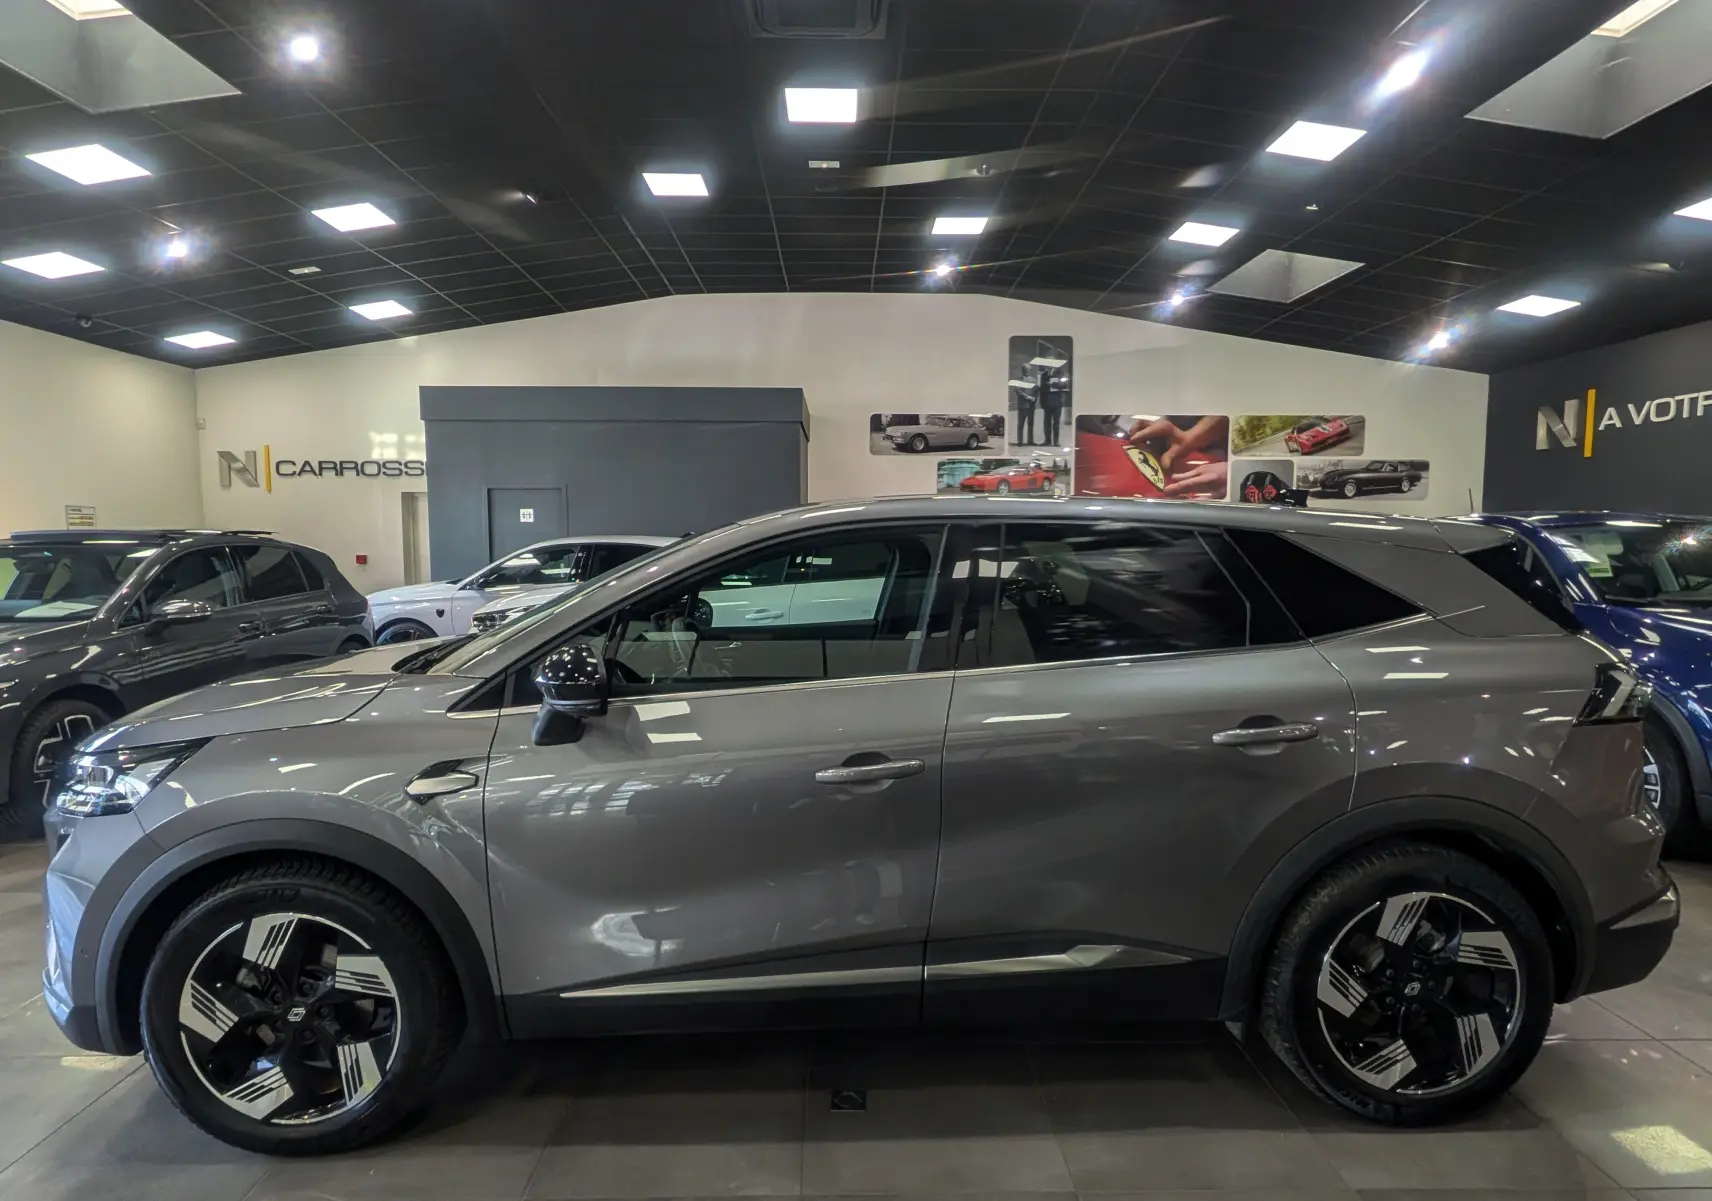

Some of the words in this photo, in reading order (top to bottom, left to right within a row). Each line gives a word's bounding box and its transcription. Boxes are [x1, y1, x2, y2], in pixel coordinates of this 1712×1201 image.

[1535, 398, 1580, 451] N
[1598, 407, 1623, 431] A
[217, 450, 260, 488] N
[275, 459, 427, 478] CARROSS
